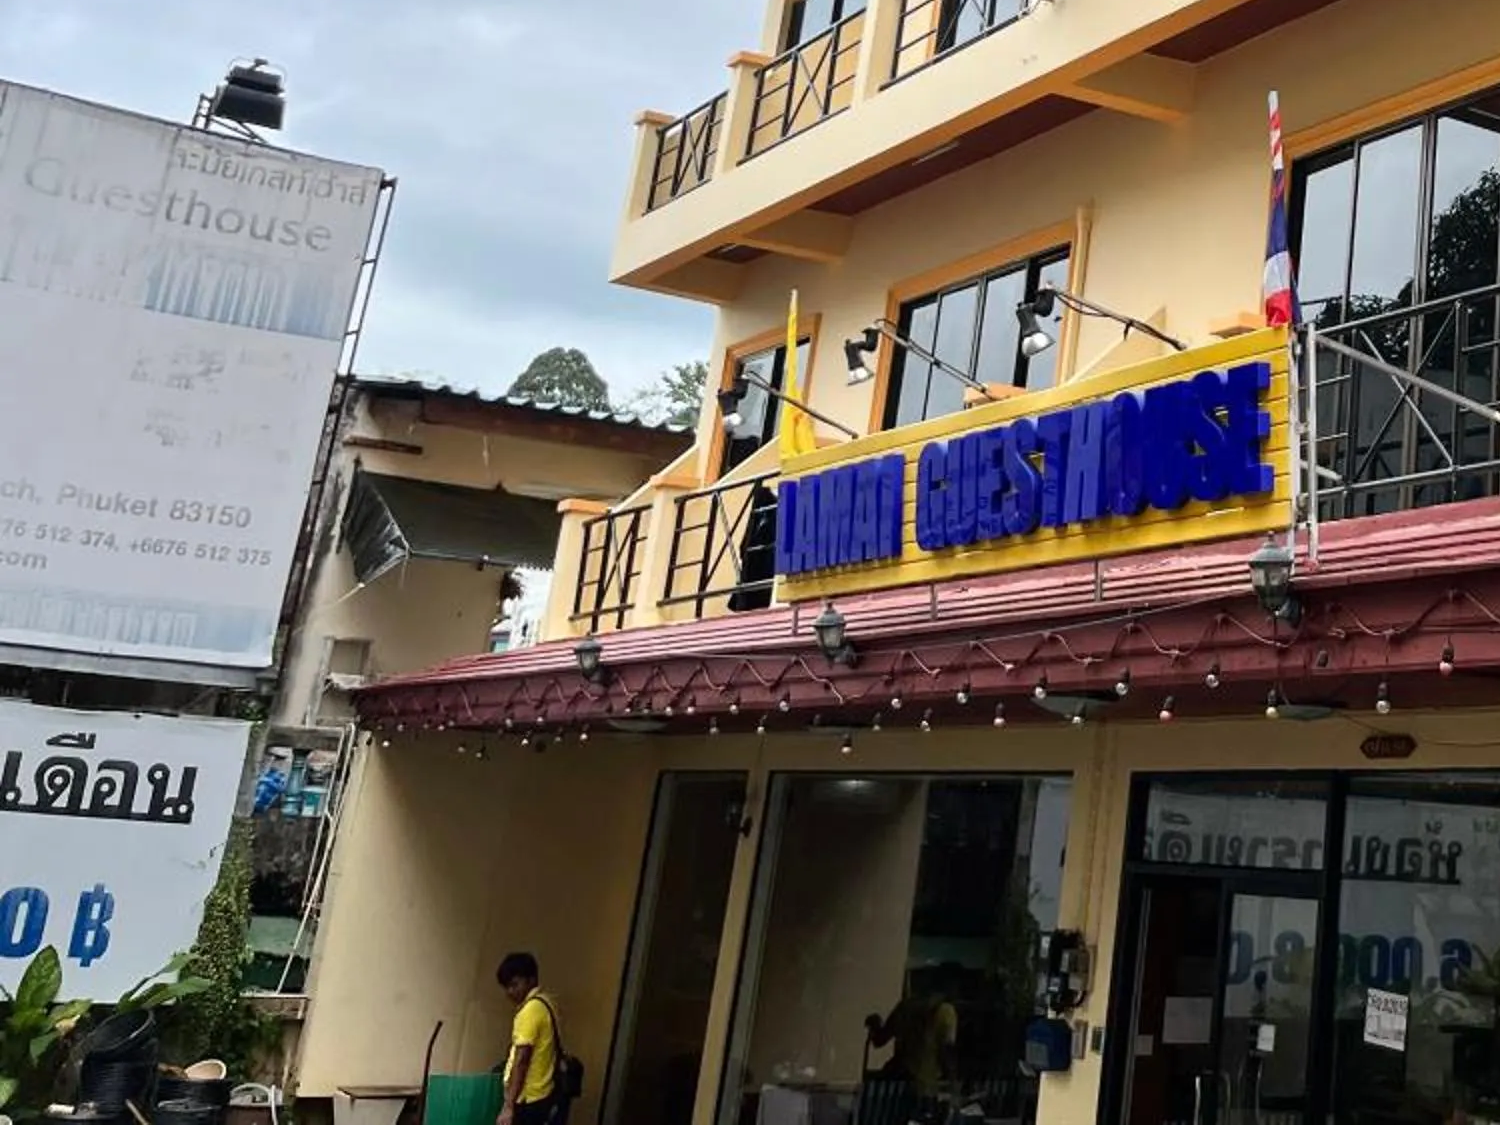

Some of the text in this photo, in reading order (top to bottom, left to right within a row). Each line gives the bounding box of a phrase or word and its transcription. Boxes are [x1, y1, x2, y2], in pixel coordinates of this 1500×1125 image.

[24, 156, 332, 252] Guesthouse
[776, 362, 1275, 575] LAMAI GUESTHOUSE
[35, 522, 73, 543] 512
[129, 537, 188, 557] +6676
[195, 542, 232, 562] 512
[237, 547, 272, 567] 375
[170, 498, 252, 529] 83150
